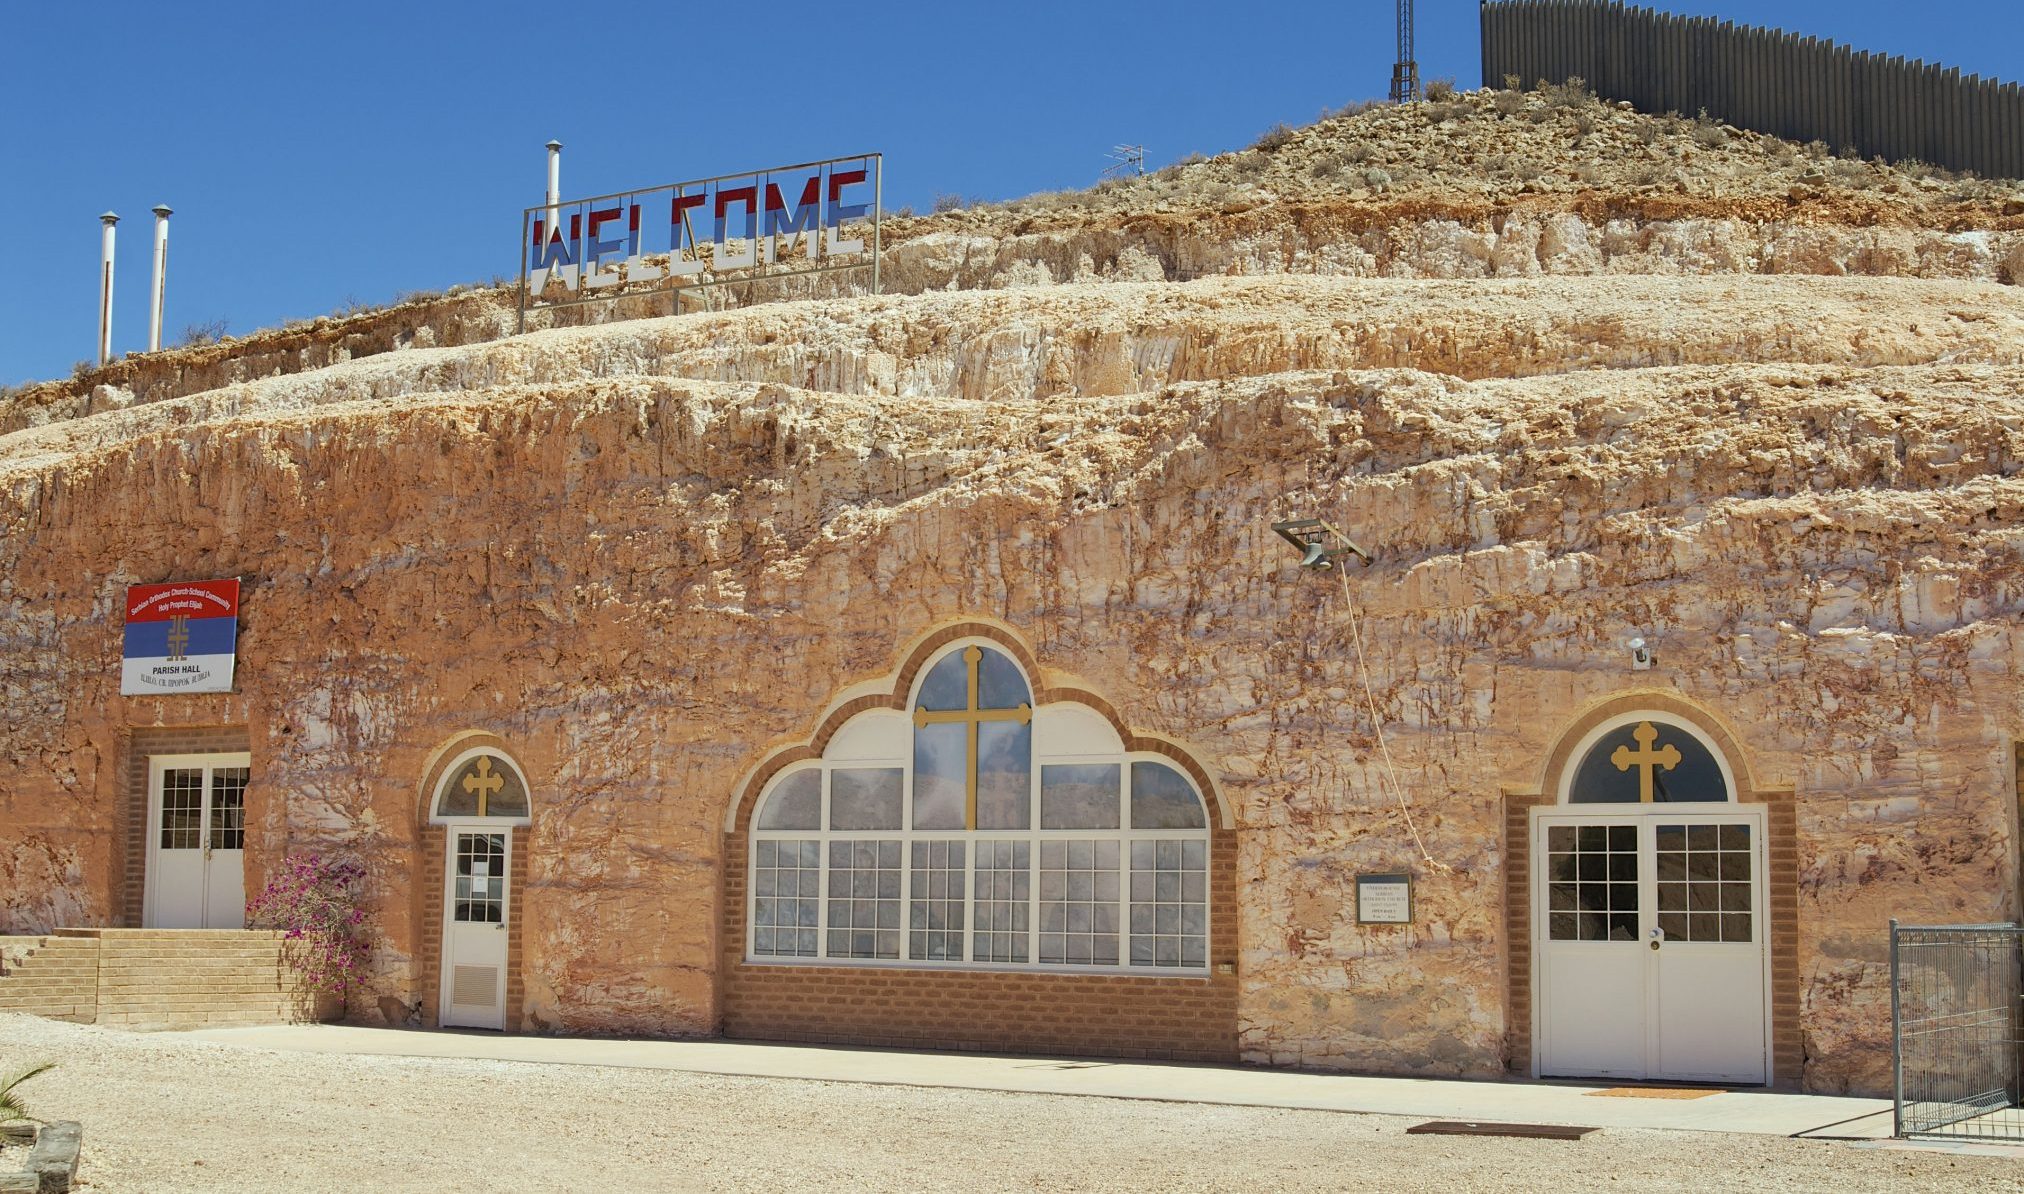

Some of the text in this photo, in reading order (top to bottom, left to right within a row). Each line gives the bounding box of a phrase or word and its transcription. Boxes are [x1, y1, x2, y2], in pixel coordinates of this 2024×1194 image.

[530, 169, 869, 298] WELCOME
[131, 600, 148, 615] Serbian
[149, 591, 170, 604] Orthodox
[206, 591, 231, 610] Community
[158, 599, 203, 613] Holy Prophet Elijah
[152, 664, 201, 675] PARISH HALL
